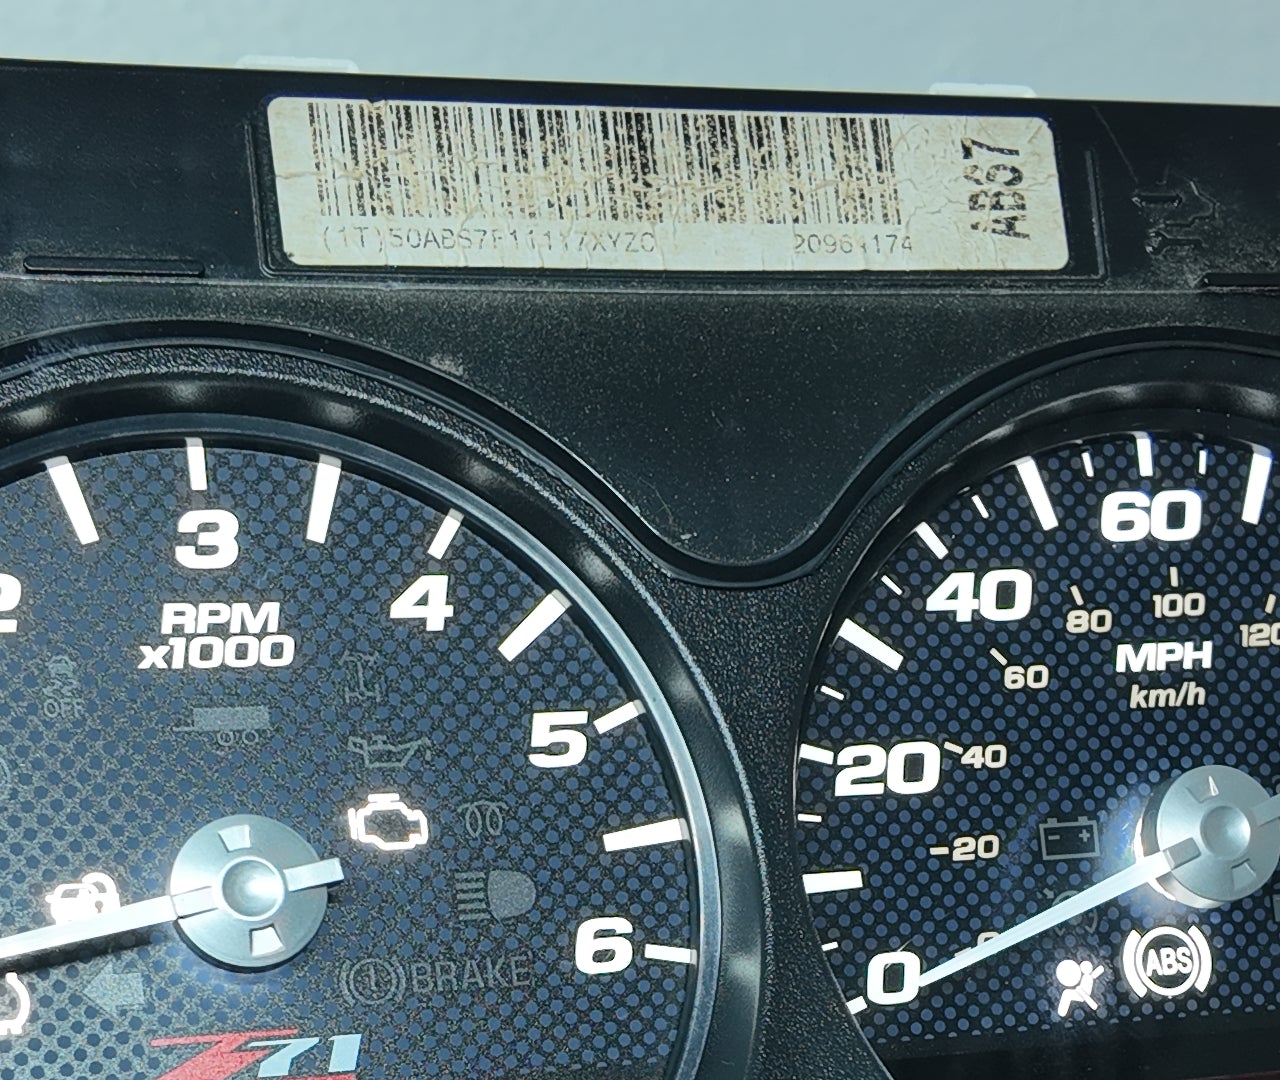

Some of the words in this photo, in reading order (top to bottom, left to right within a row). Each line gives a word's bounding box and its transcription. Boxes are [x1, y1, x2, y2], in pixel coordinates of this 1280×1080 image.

[1101, 490, 1202, 542] 60
[175, 509, 239, 570] 3
[389, 574, 454, 631] 4
[926, 568, 1033, 622] 40
[1153, 592, 1206, 618] 100
[160, 601, 280, 635] RPM
[1065, 608, 1112, 633] 80
[137, 634, 295, 669] x1000
[1115, 640, 1213, 673] MPH
[1004, 664, 1049, 690] 60
[1129, 681, 1207, 709] km/h
[527, 710, 589, 769] 5
[960, 743, 1008, 769] 40
[834, 740, 941, 797] 20
[952, 834, 1001, 861] 20
[574, 916, 634, 975] 6
[1146, 945, 1195, 978] ABS
[410, 953, 533, 994] BRAKE
[866, 951, 921, 1006] 0
